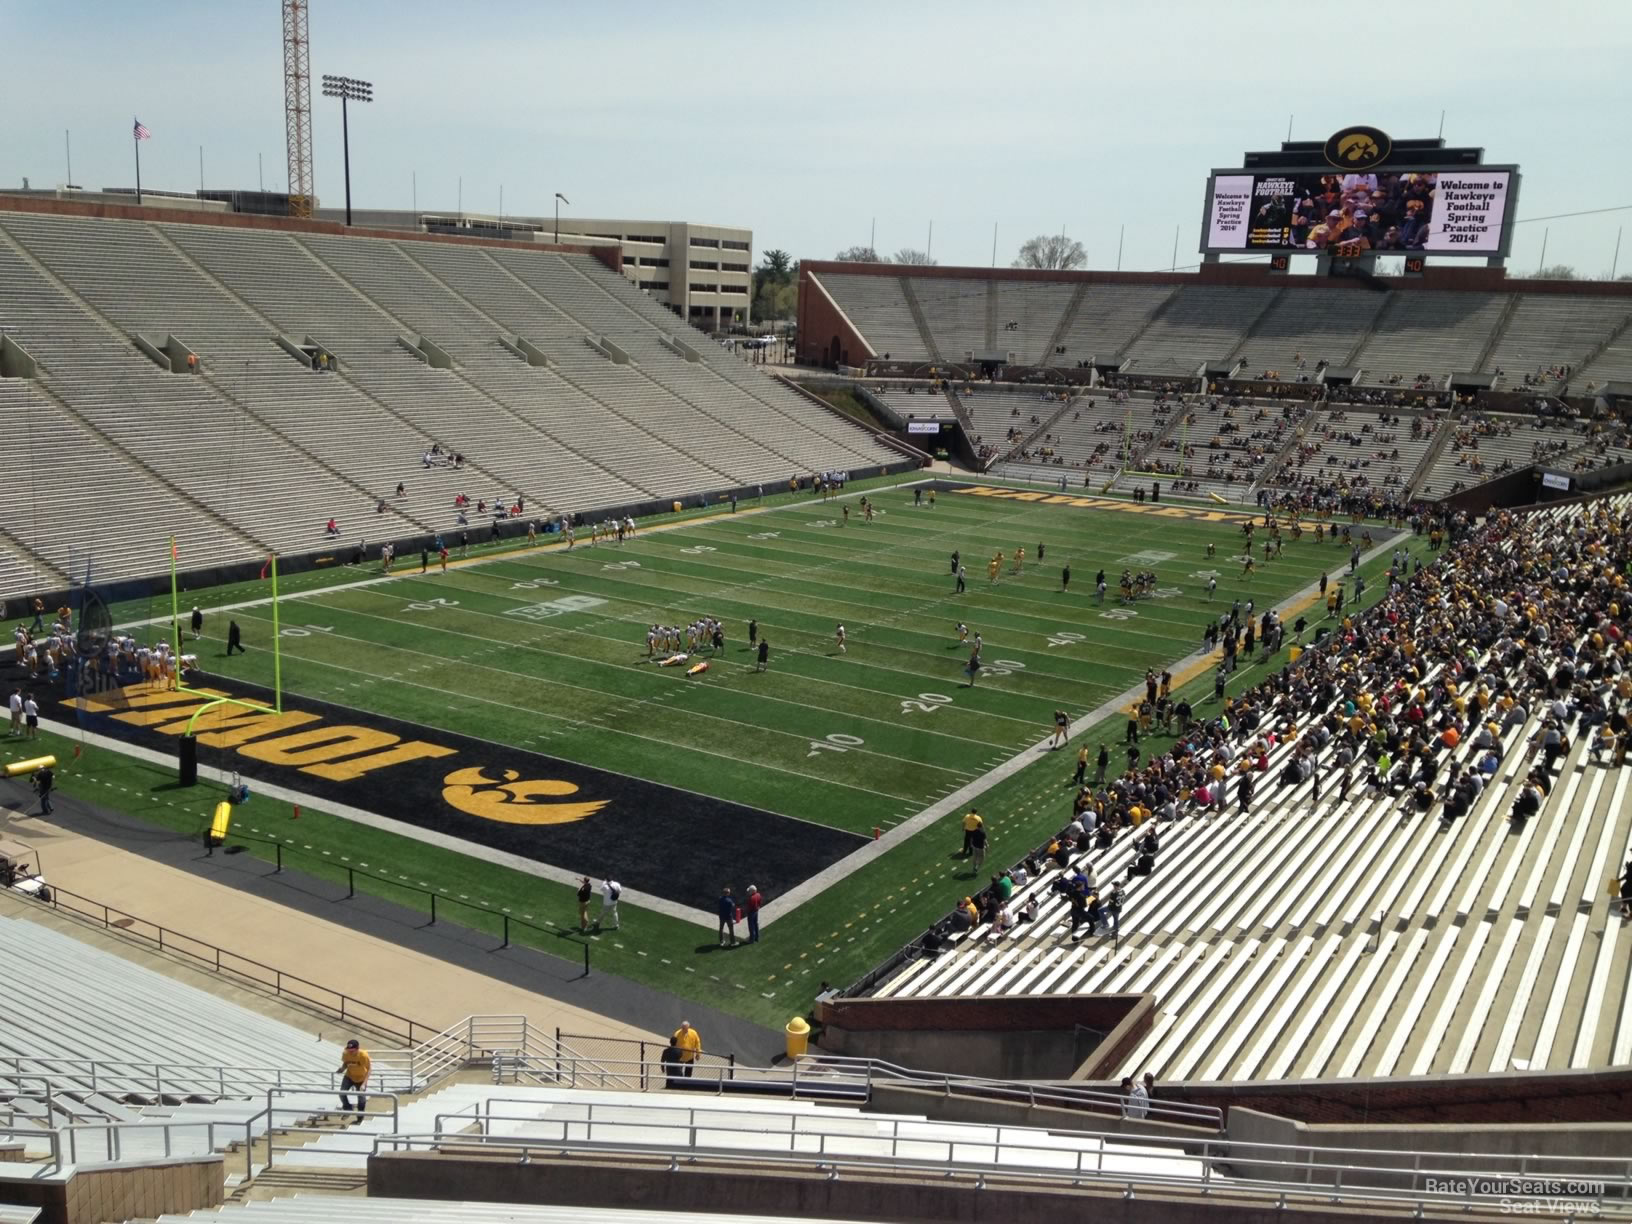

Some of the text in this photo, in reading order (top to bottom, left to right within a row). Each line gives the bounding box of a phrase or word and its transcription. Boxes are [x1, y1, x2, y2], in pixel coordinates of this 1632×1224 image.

[1441, 181, 1503, 190] Welcome to
[1255, 188, 1294, 196] FOOTBALL
[1444, 192, 1495, 202] Hawkeye
[1446, 201, 1490, 211] Football
[1447, 212, 1486, 223] Spring
[1442, 223, 1488, 233] Practice
[1448, 234, 1479, 243] 2014!
[1273, 257, 1286, 269] 40
[1407, 259, 1421, 271] 40
[407, 597, 460, 611] 20
[1099, 608, 1139, 620] 50
[280, 624, 334, 637] 10
[1046, 631, 1087, 645] 40
[978, 659, 1027, 676] 30
[900, 692, 954, 711] 20
[58, 680, 459, 781] IOWA
[809, 733, 865, 751] 10
